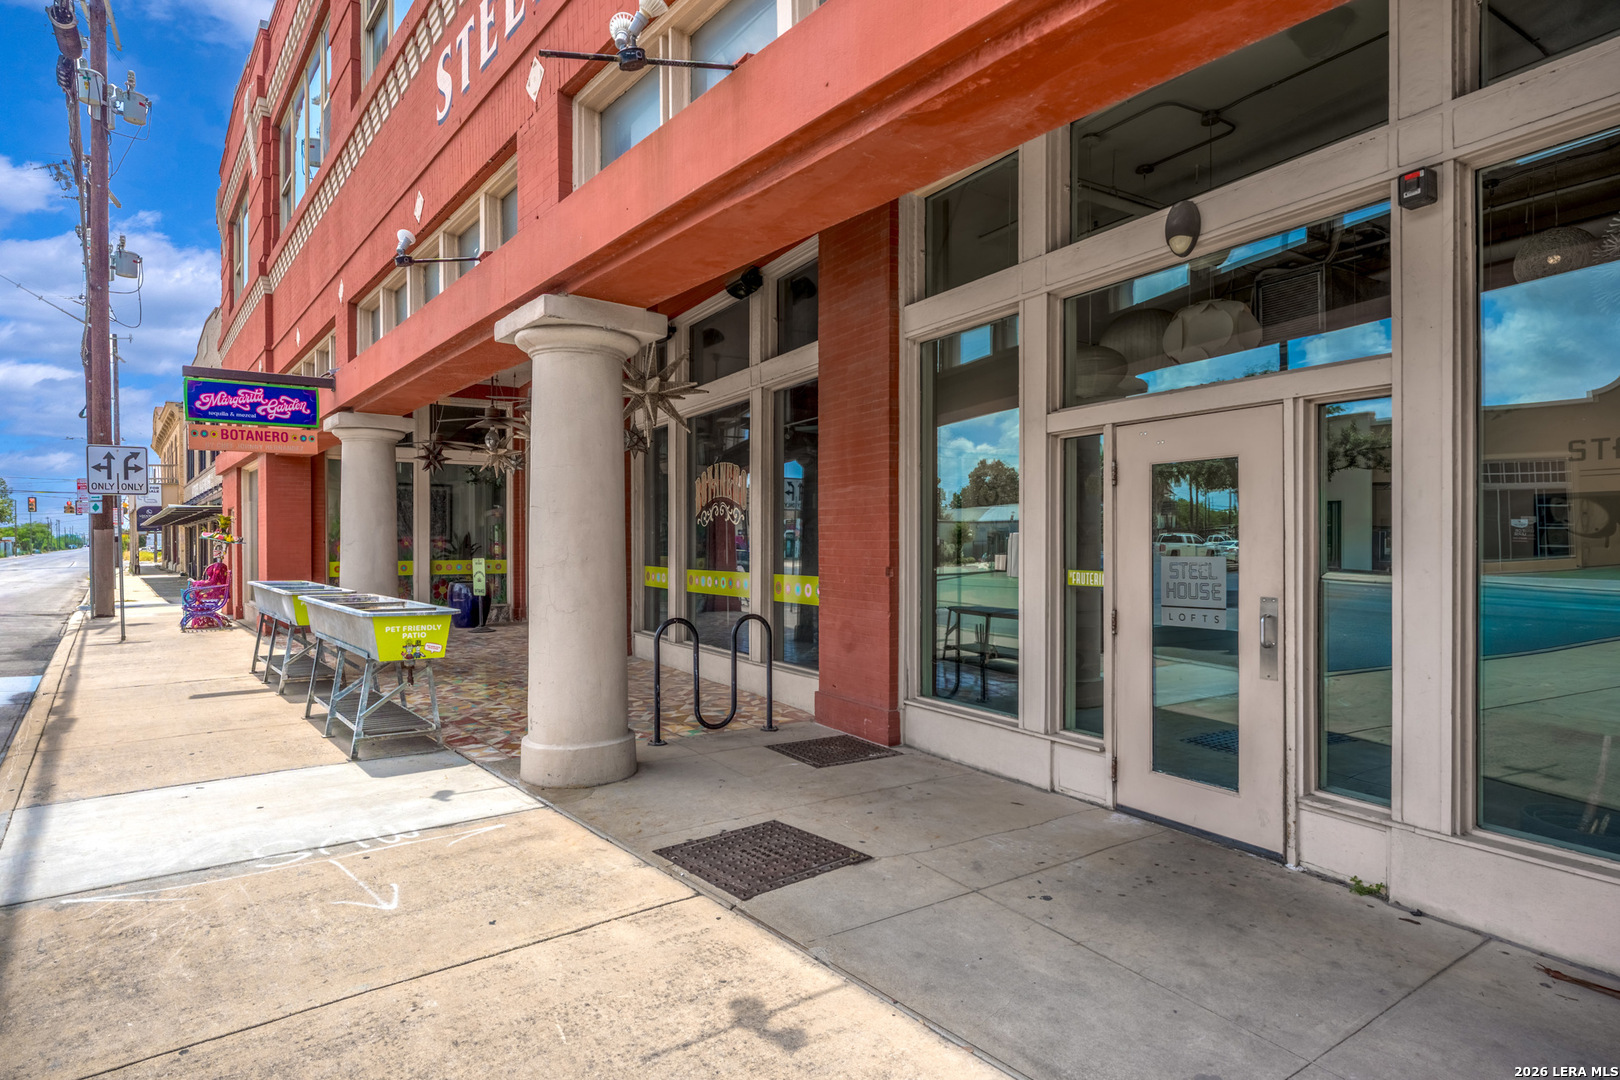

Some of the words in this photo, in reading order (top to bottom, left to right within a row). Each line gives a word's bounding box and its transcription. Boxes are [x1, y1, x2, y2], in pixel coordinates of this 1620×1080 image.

[194, 388, 268, 411] Margarita
[256, 395, 311, 420] Garden
[220, 428, 289, 443] BOTANERO
[91, 482, 115, 491] ONLY
[121, 482, 144, 491] ONLY
[1169, 562, 1218, 580] STEEL
[1166, 581, 1222, 601] HOUSE
[1168, 612, 1220, 624] LOFTS
[385, 625, 401, 633] PET
[402, 624, 442, 632] FRIENDLY
